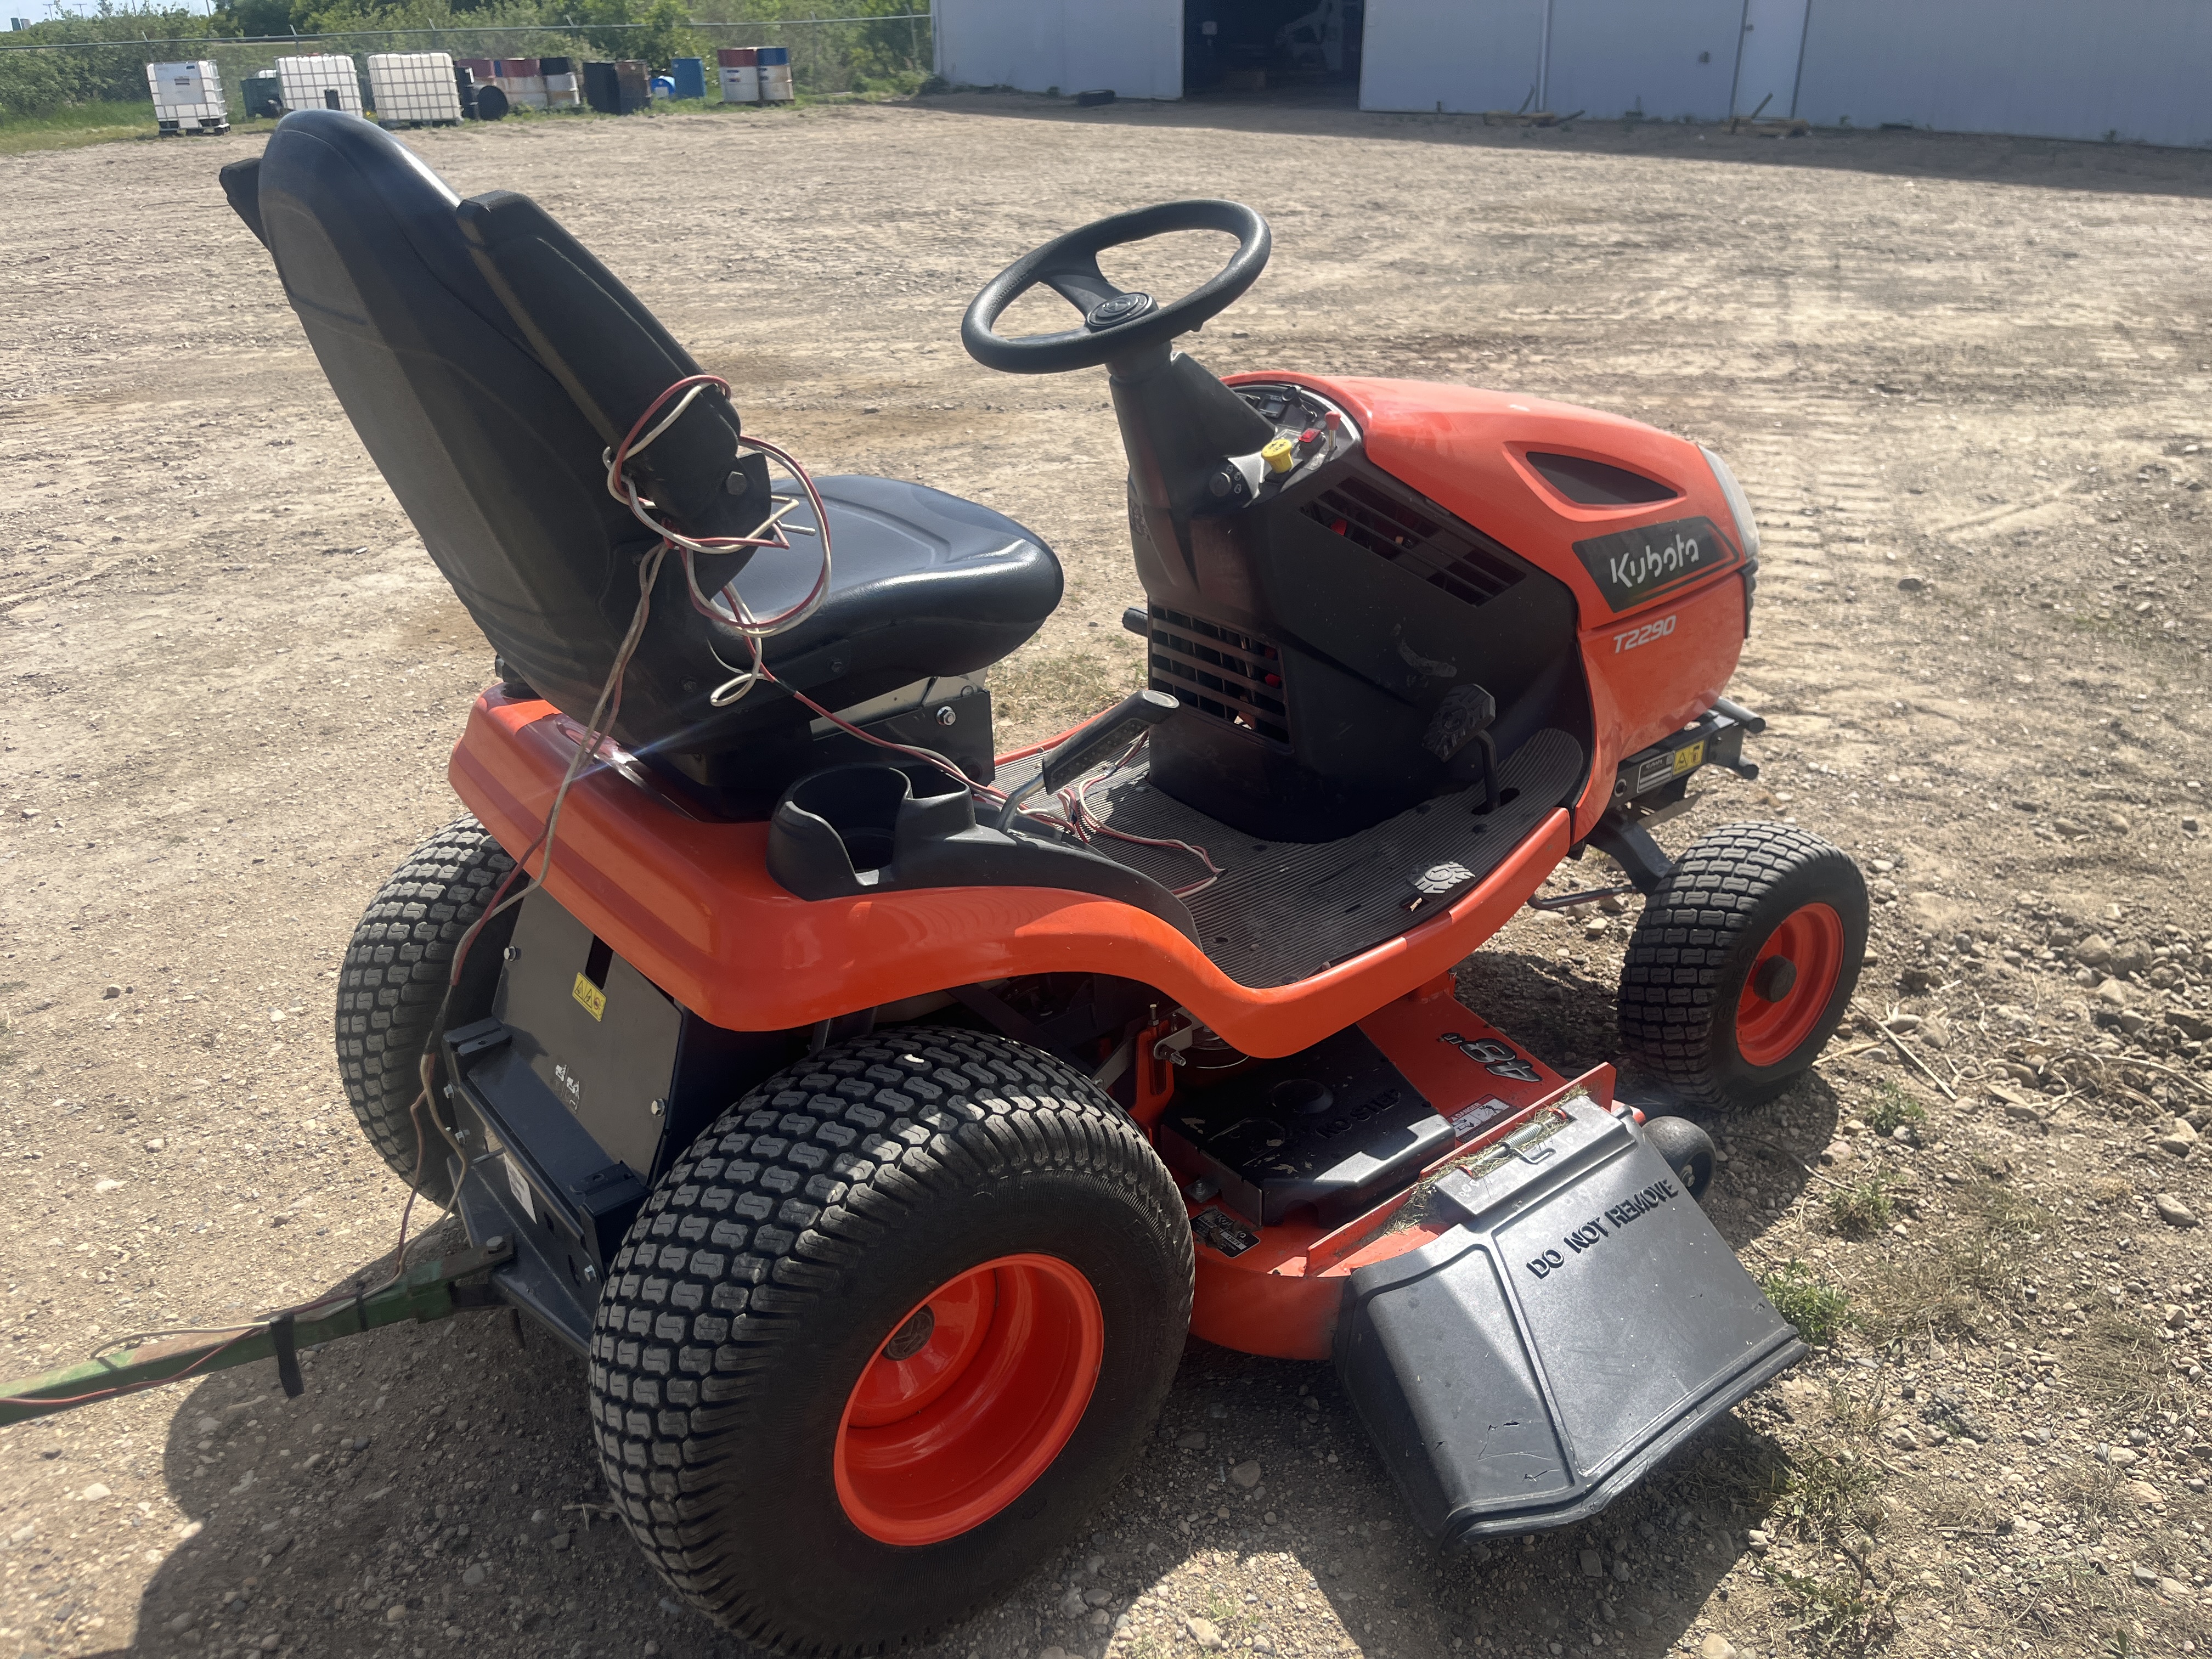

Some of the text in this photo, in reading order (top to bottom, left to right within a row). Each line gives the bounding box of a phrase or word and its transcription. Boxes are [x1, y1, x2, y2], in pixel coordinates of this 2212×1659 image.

[1610, 534, 1700, 588] Kubota
[1613, 615, 1676, 654] T2290
[1315, 1088, 1401, 1139] NO STEP
[1456, 1102, 1482, 1119] DANGER
[1526, 1179, 1679, 1279] DO NOT REMOVE
